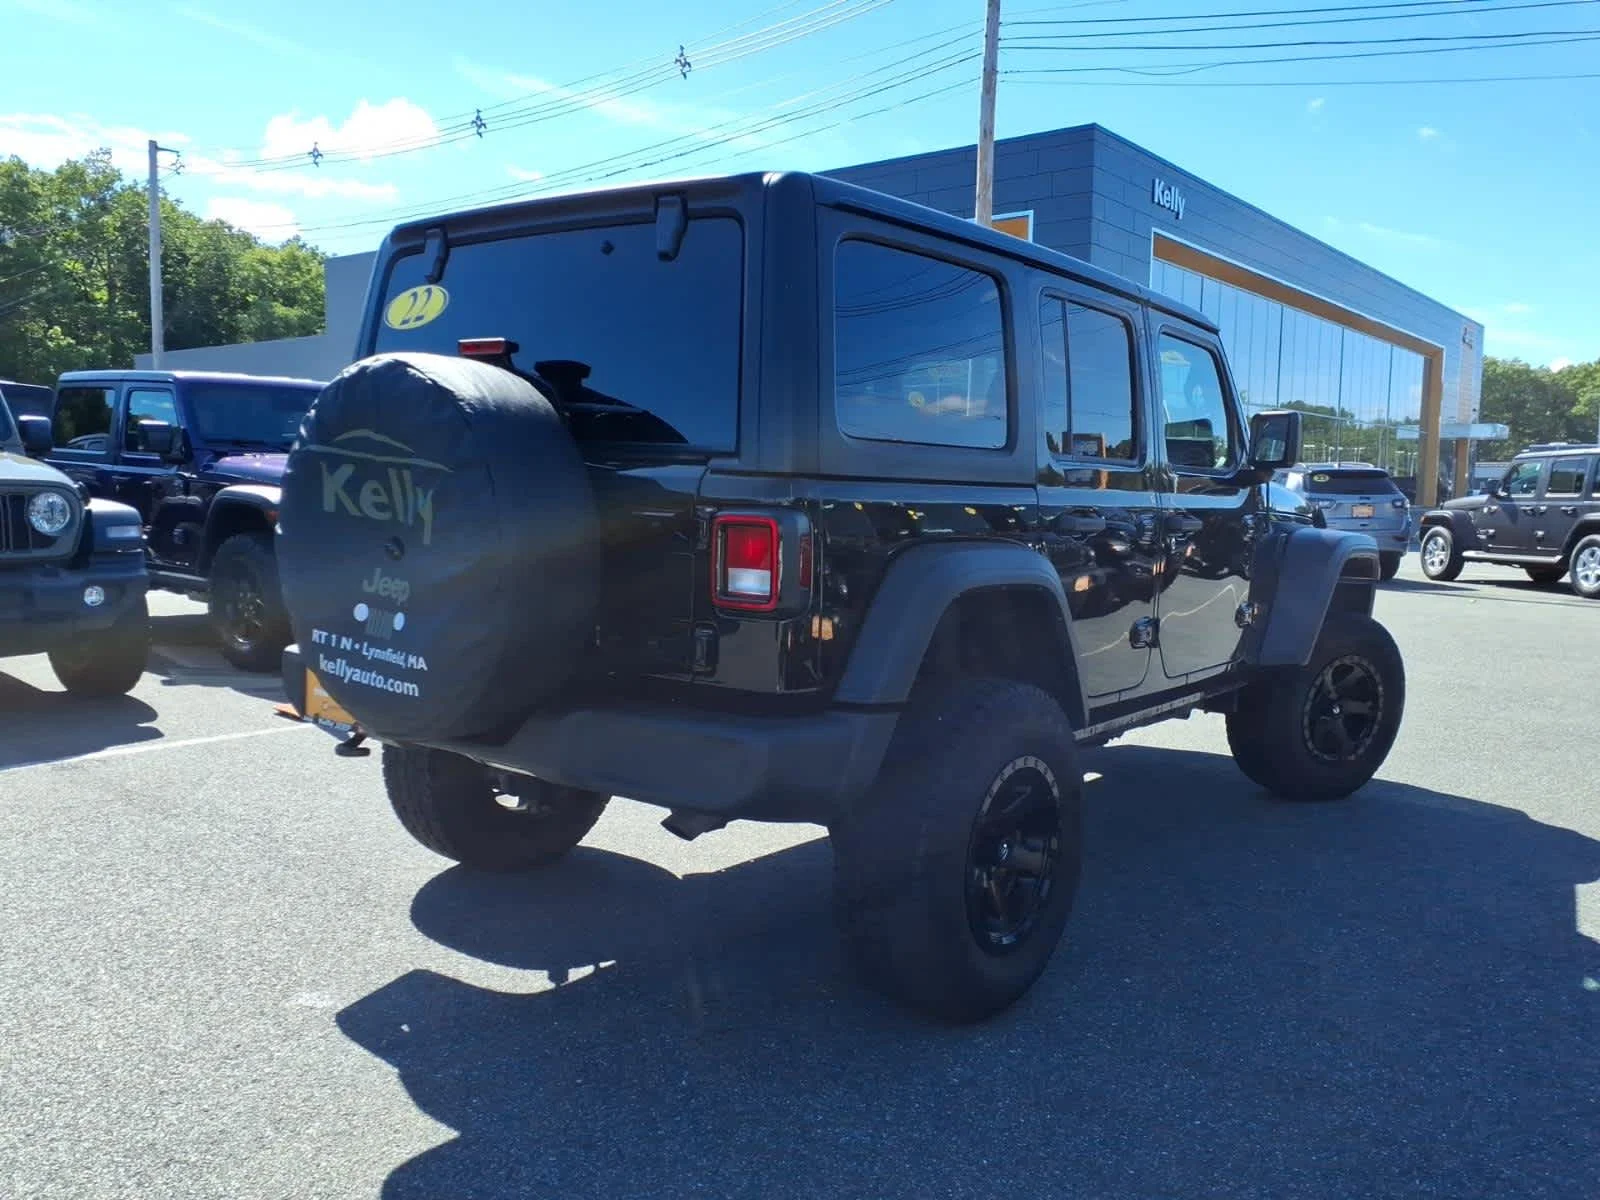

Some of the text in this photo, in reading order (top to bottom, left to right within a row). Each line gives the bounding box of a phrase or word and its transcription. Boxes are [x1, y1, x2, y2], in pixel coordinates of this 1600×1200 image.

[1153, 178, 1185, 220] Kelly
[399, 287, 432, 325] 22
[320, 462, 434, 545] Kelly
[362, 568, 411, 606] Jeep
[312, 629, 328, 645] RT
[331, 634, 337, 647] 1
[340, 636, 353, 651] N
[407, 654, 428, 671] MA
[319, 653, 419, 697] kellyauto.com
